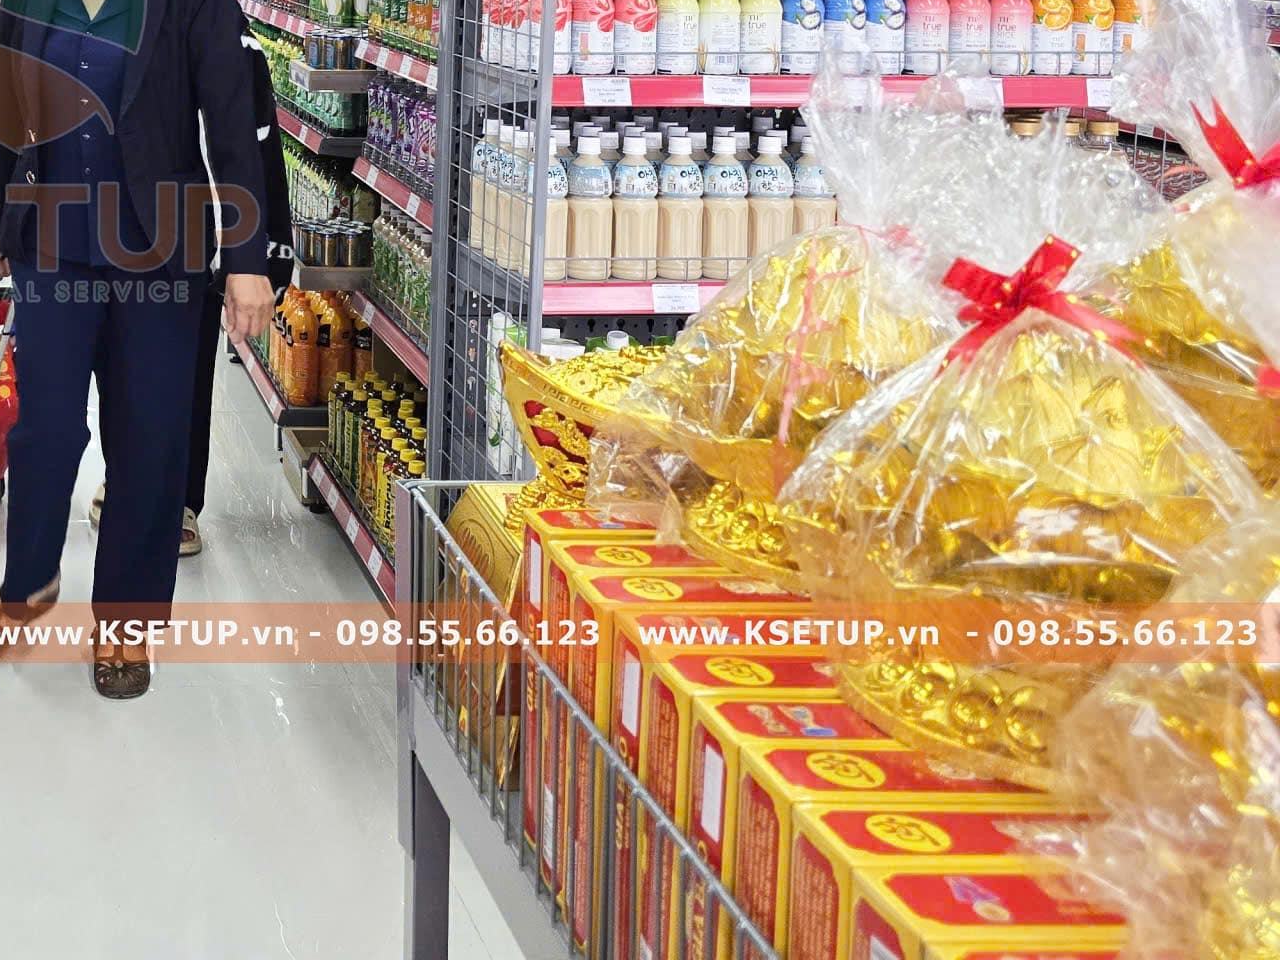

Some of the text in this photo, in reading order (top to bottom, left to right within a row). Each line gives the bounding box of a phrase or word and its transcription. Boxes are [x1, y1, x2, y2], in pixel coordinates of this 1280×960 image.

[748, 21, 767, 30] true
[922, 23, 942, 32] true
[966, 23, 984, 32] true
[997, 23, 1017, 32] true
[680, 169, 700, 182] 아침
[720, 170, 743, 182] 아침
[755, 169, 779, 182] 아침
